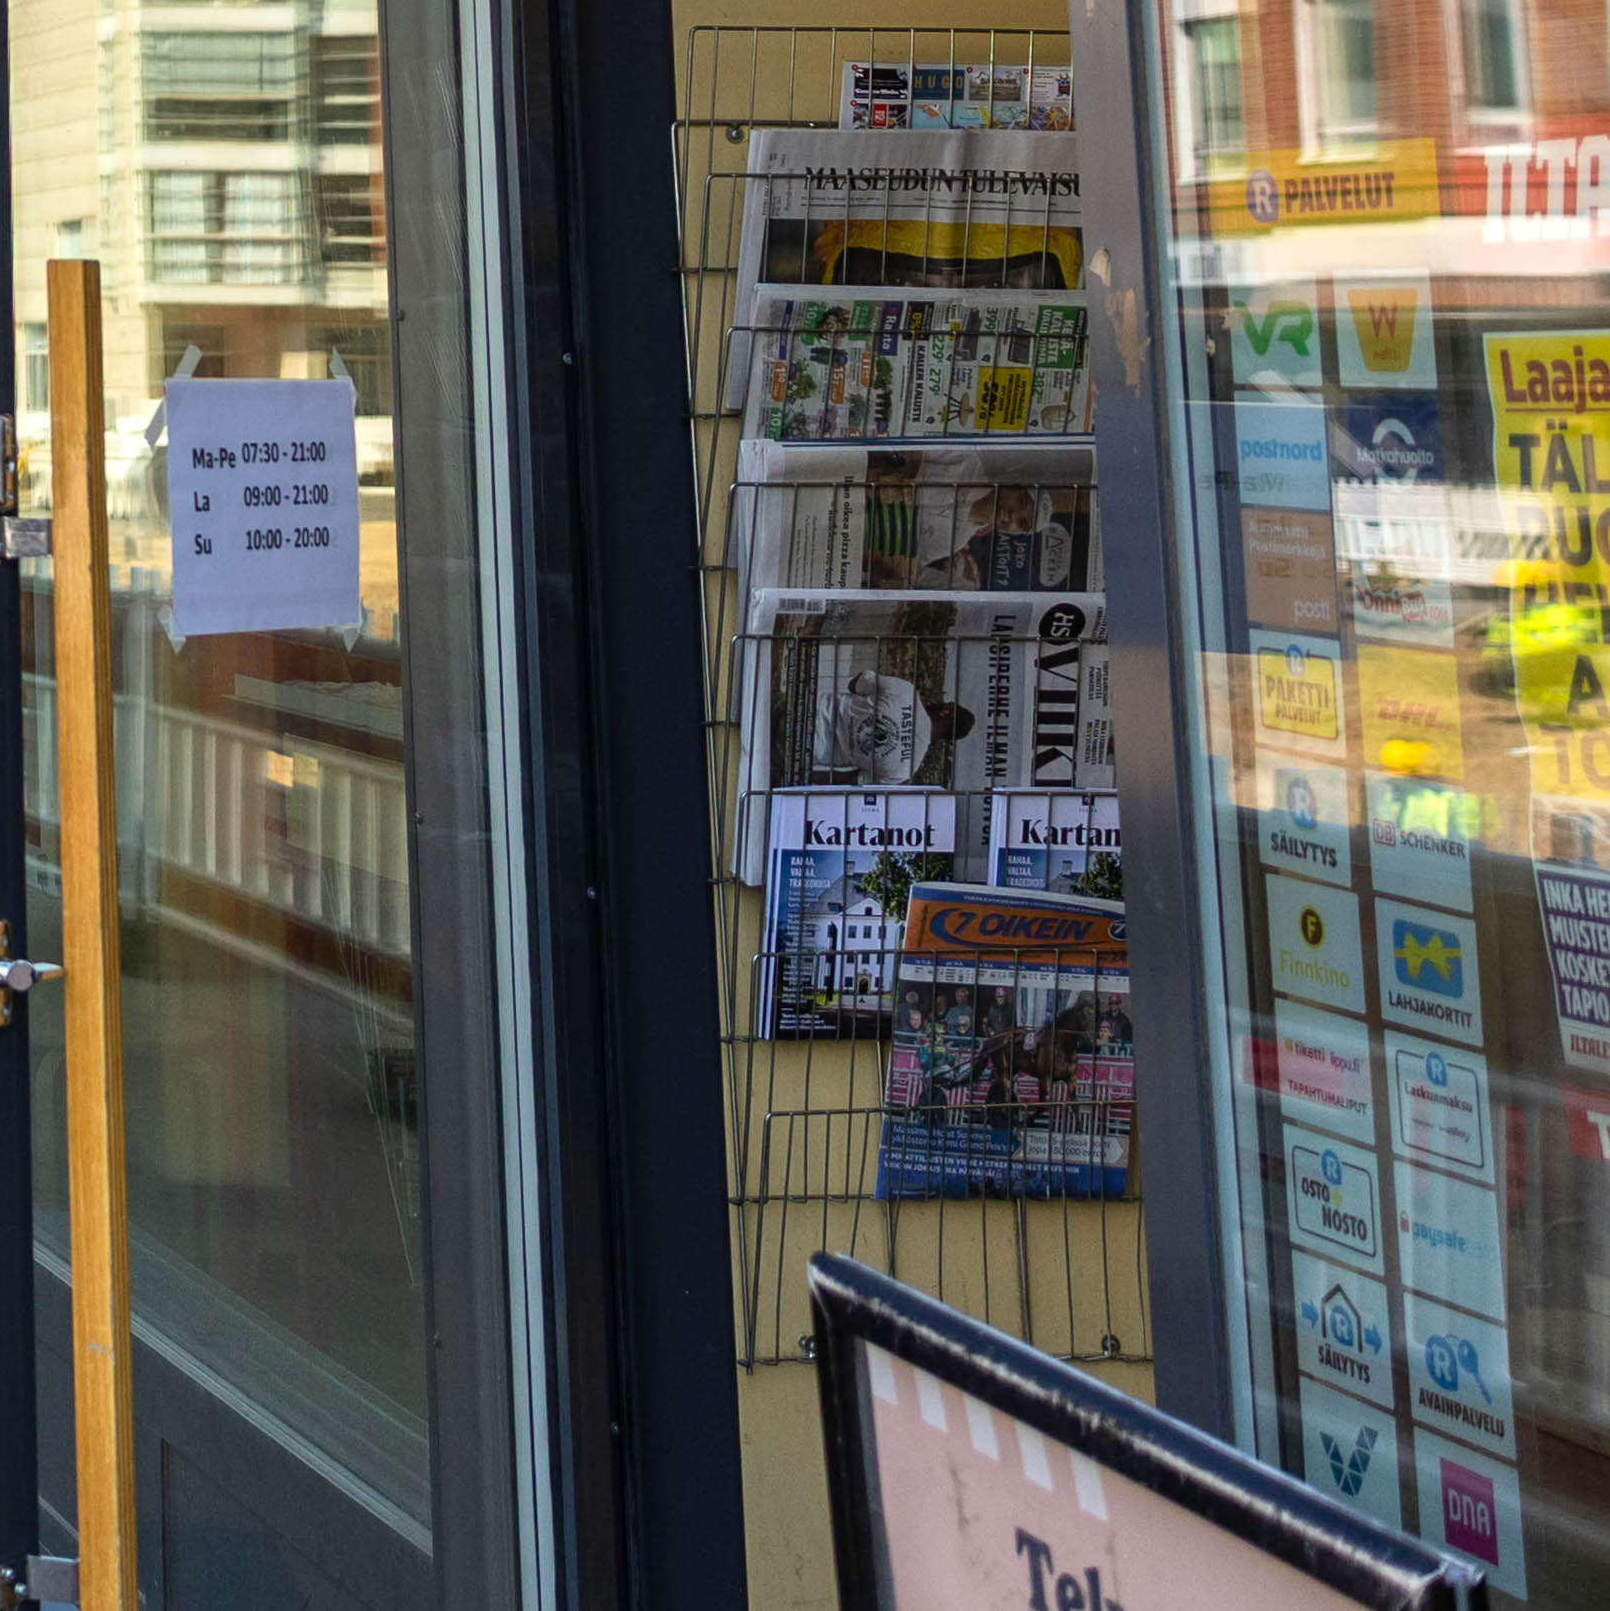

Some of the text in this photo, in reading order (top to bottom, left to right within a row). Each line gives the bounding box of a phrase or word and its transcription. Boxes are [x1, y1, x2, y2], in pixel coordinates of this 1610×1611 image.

[1284, 171, 1396, 214] PALVELUT
[1234, 299, 1314, 357] VR
[192, 448, 237, 470] Ma-Pe
[242, 442, 280, 464] 07:30
[291, 441, 327, 463] 21:00
[1239, 438, 1323, 462] postnord
[194, 491, 211, 513] La
[243, 485, 282, 507] 09:00
[293, 484, 329, 506] 21:00
[194, 534, 213, 556] Su
[245, 528, 283, 551] 10:00
[293, 526, 331, 548] 20:00
[1264, 674, 1330, 710] PAKETTI
[900, 704, 913, 764] TASTEFUL
[805, 820, 936, 847] Kartanot
[1270, 831, 1338, 869] SÄILYTYS
[1399, 830, 1466, 859] SCHENKER
[1543, 878, 1582, 913] INKA
[979, 913, 1095, 941] OIKEIN
[1280, 949, 1351, 989] Finnkino
[1388, 990, 1473, 1030] LAHJAKORTIT
[1288, 1079, 1369, 1116] TAPAHTUMALIPUT
[1404, 1081, 1473, 1113] Laskunmaksu
[1300, 1176, 1331, 1203] OSTO
[1322, 1204, 1368, 1242] NOSTO
[1318, 1344, 1371, 1385] SÄILYTYS
[1417, 1390, 1506, 1440] AVAINPALVELU
[1446, 1489, 1492, 1538] DNA
[1014, 1526, 1123, 1611] Tel
